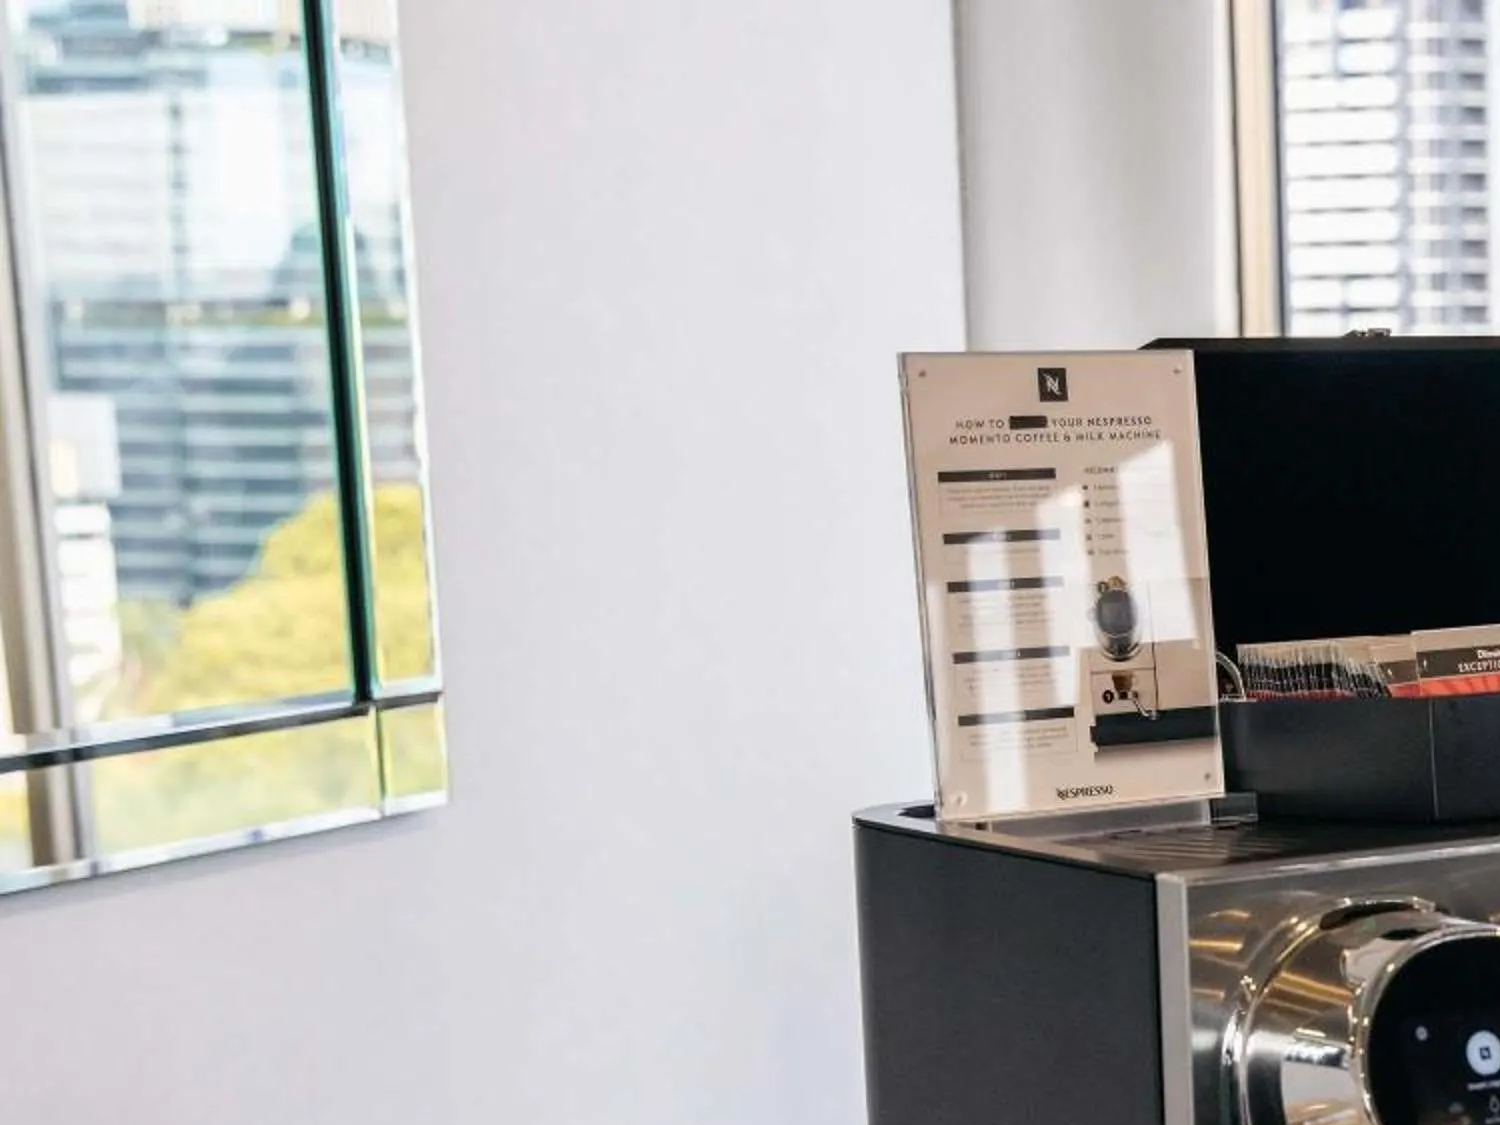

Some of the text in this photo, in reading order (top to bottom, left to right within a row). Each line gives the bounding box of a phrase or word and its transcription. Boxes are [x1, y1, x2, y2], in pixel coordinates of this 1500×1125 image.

[956, 415, 1153, 429] HOW TO YOUR NESPRESSO
[950, 433, 1011, 445] MOMENTO
[1015, 432, 1060, 443] COFFEE
[1075, 431, 1104, 441] MILK
[1108, 430, 1162, 440] MACHINE
[1055, 784, 1114, 801] NESPRESSO
